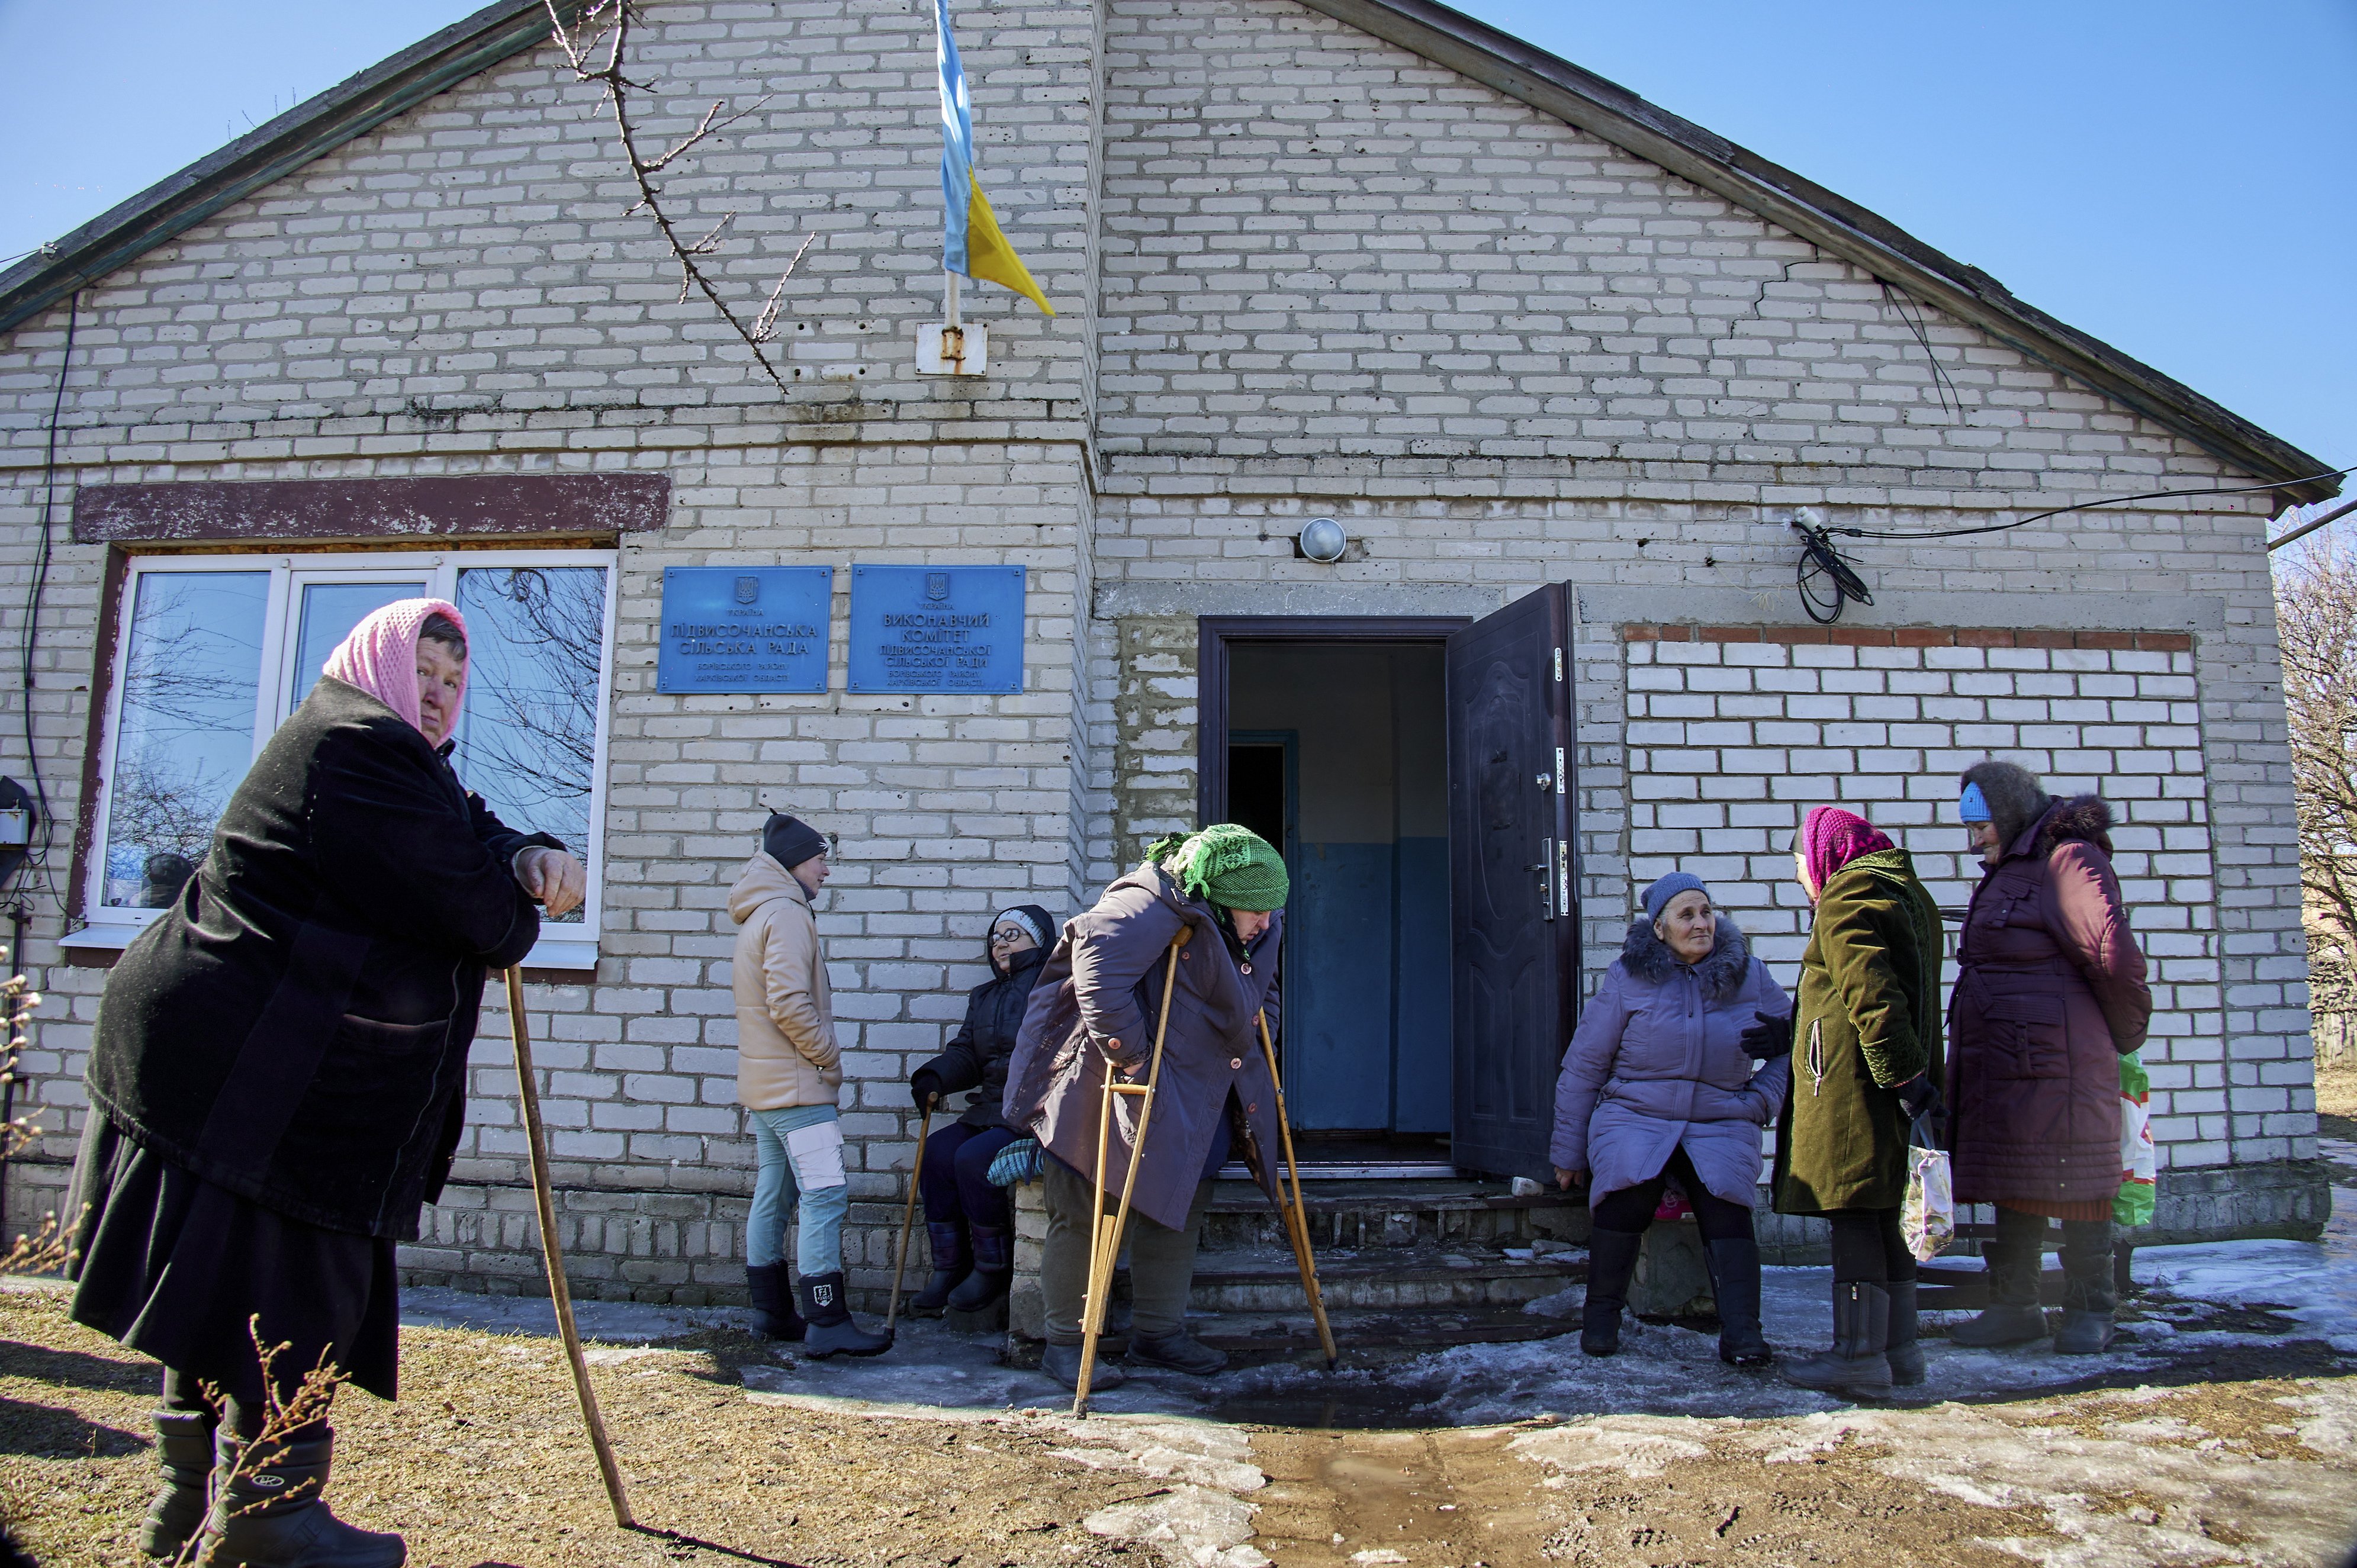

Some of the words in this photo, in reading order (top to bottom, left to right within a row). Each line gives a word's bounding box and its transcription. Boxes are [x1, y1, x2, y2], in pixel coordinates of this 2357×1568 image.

[727, 608, 764, 616] УКРАЇНА
[918, 602, 955, 610] УКРАЇНА
[884, 612, 990, 627] ВИКОНАВЧИЙ
[671, 623, 818, 637] ПІДВИСОЧАНСЬКА
[902, 628, 970, 643] КОМІТЕТ
[680, 640, 757, 655] СІЛЬСЬКА
[768, 641, 809, 655] РАДА
[880, 645, 992, 656] ПІДВИСОЧАНСЬКОЇ
[885, 656, 950, 667] СІЛЬСЬКОЇ
[956, 657, 988, 668] РАДИ
[949, 669, 983, 678] РАЙОНУ
